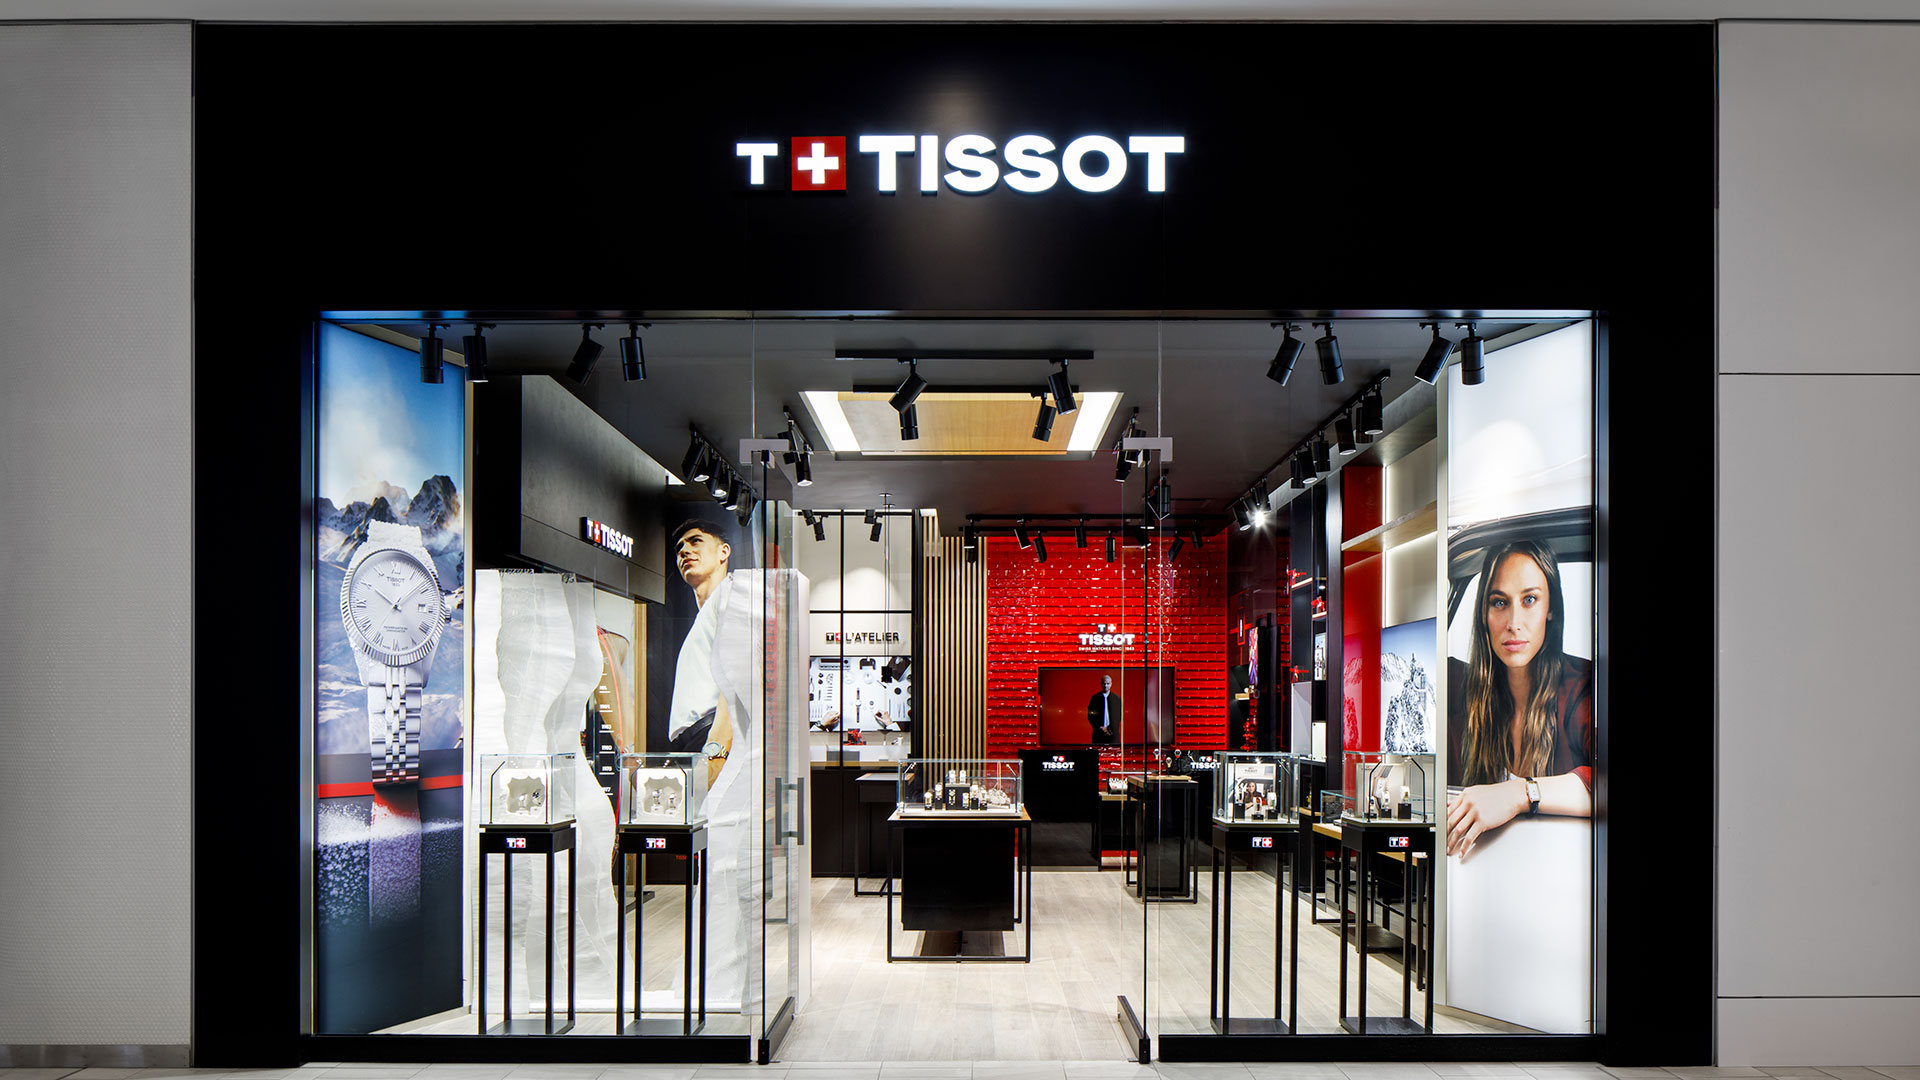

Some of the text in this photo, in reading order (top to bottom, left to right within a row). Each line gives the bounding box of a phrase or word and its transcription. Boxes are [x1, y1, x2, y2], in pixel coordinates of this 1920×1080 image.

[736, 134, 1185, 192] T TISSOT
[600, 523, 633, 558] TISSOT
[845, 632, 900, 641] L'ATELIER
[1078, 634, 1135, 645] TISSOT
